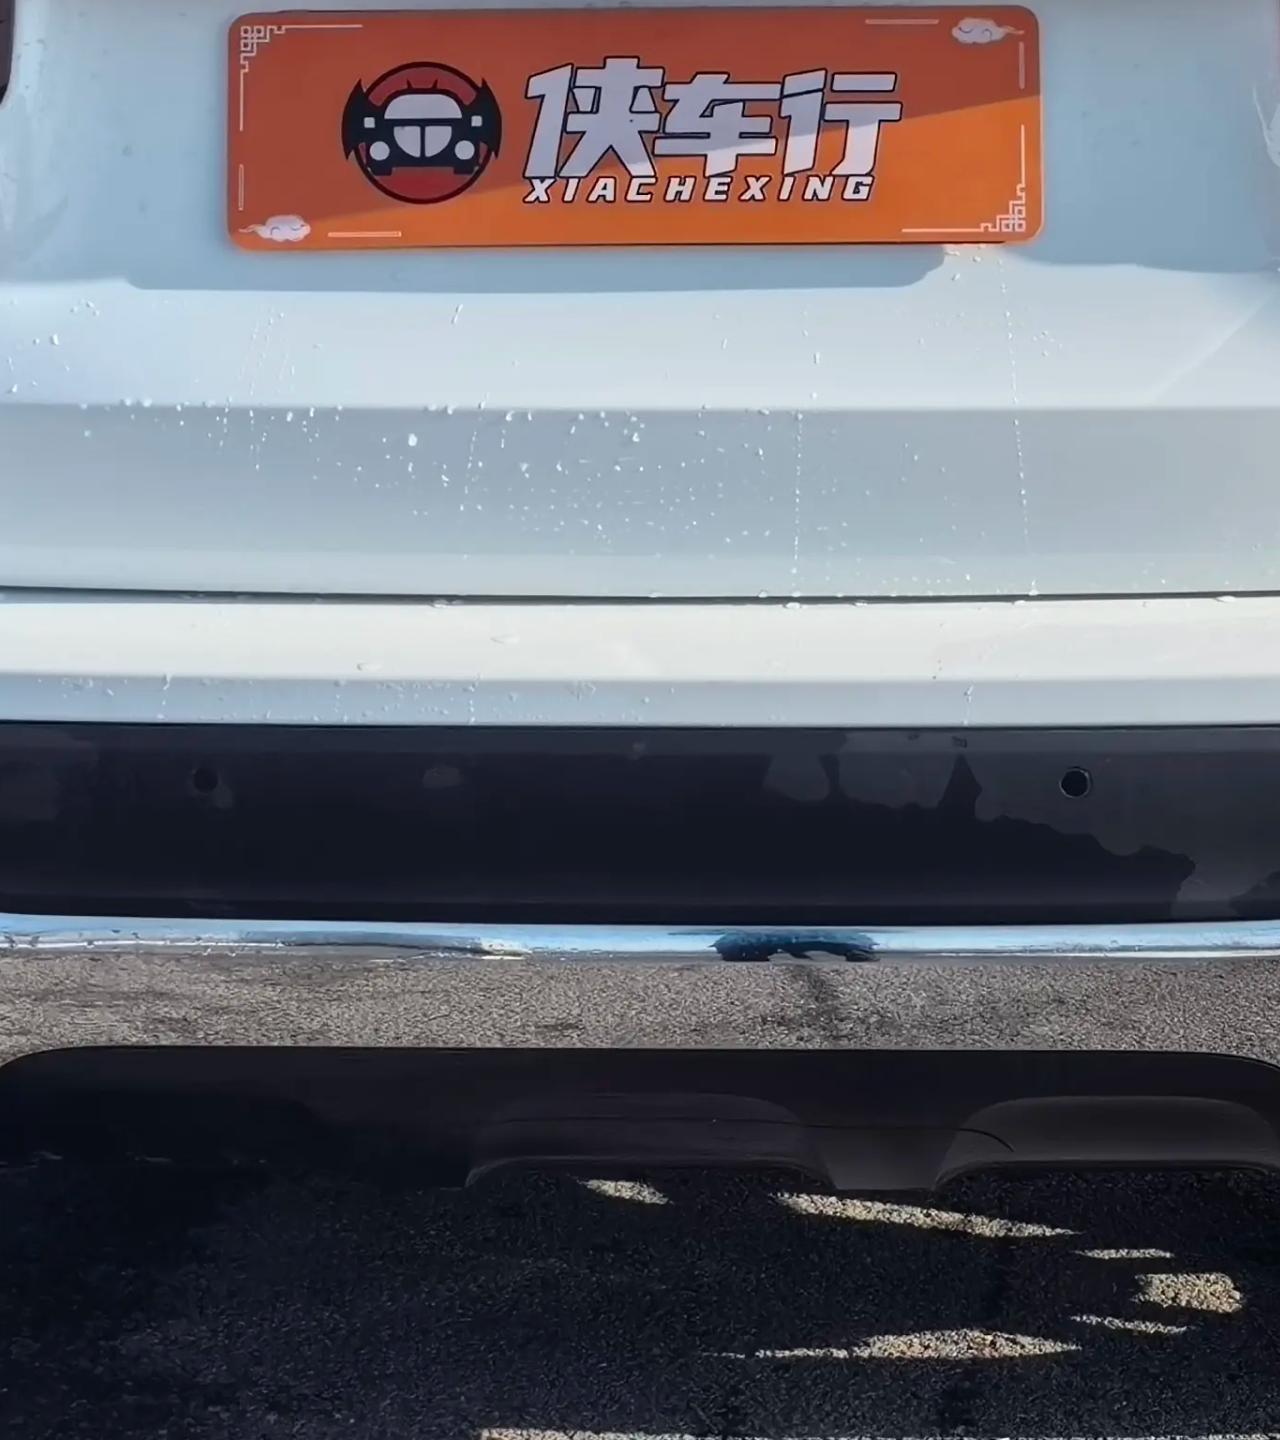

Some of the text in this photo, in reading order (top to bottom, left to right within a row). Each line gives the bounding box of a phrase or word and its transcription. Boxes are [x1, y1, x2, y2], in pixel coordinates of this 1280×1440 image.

[521, 55, 903, 178] 侠车行
[522, 174, 875, 203] XIACHEXING
